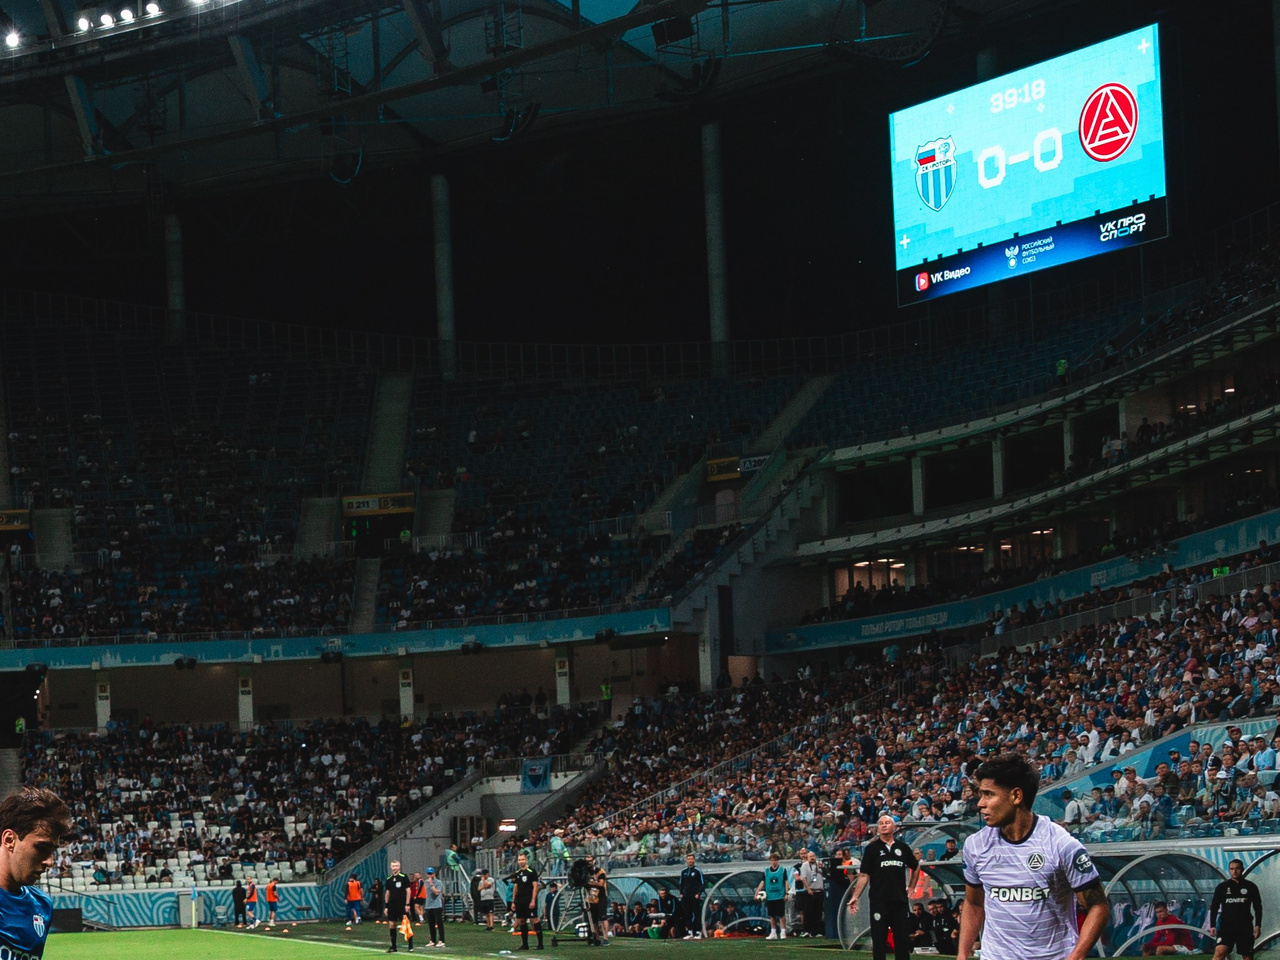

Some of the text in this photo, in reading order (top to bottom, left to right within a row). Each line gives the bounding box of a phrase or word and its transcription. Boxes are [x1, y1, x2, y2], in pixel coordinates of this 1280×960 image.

[990, 79, 1046, 113] 39:18
[1100, 213, 1146, 233] VK ПРО
[1100, 222, 1146, 242] СПОРТ
[931, 266, 971, 284] VK Видео
[989, 886, 1051, 902] FONBET
